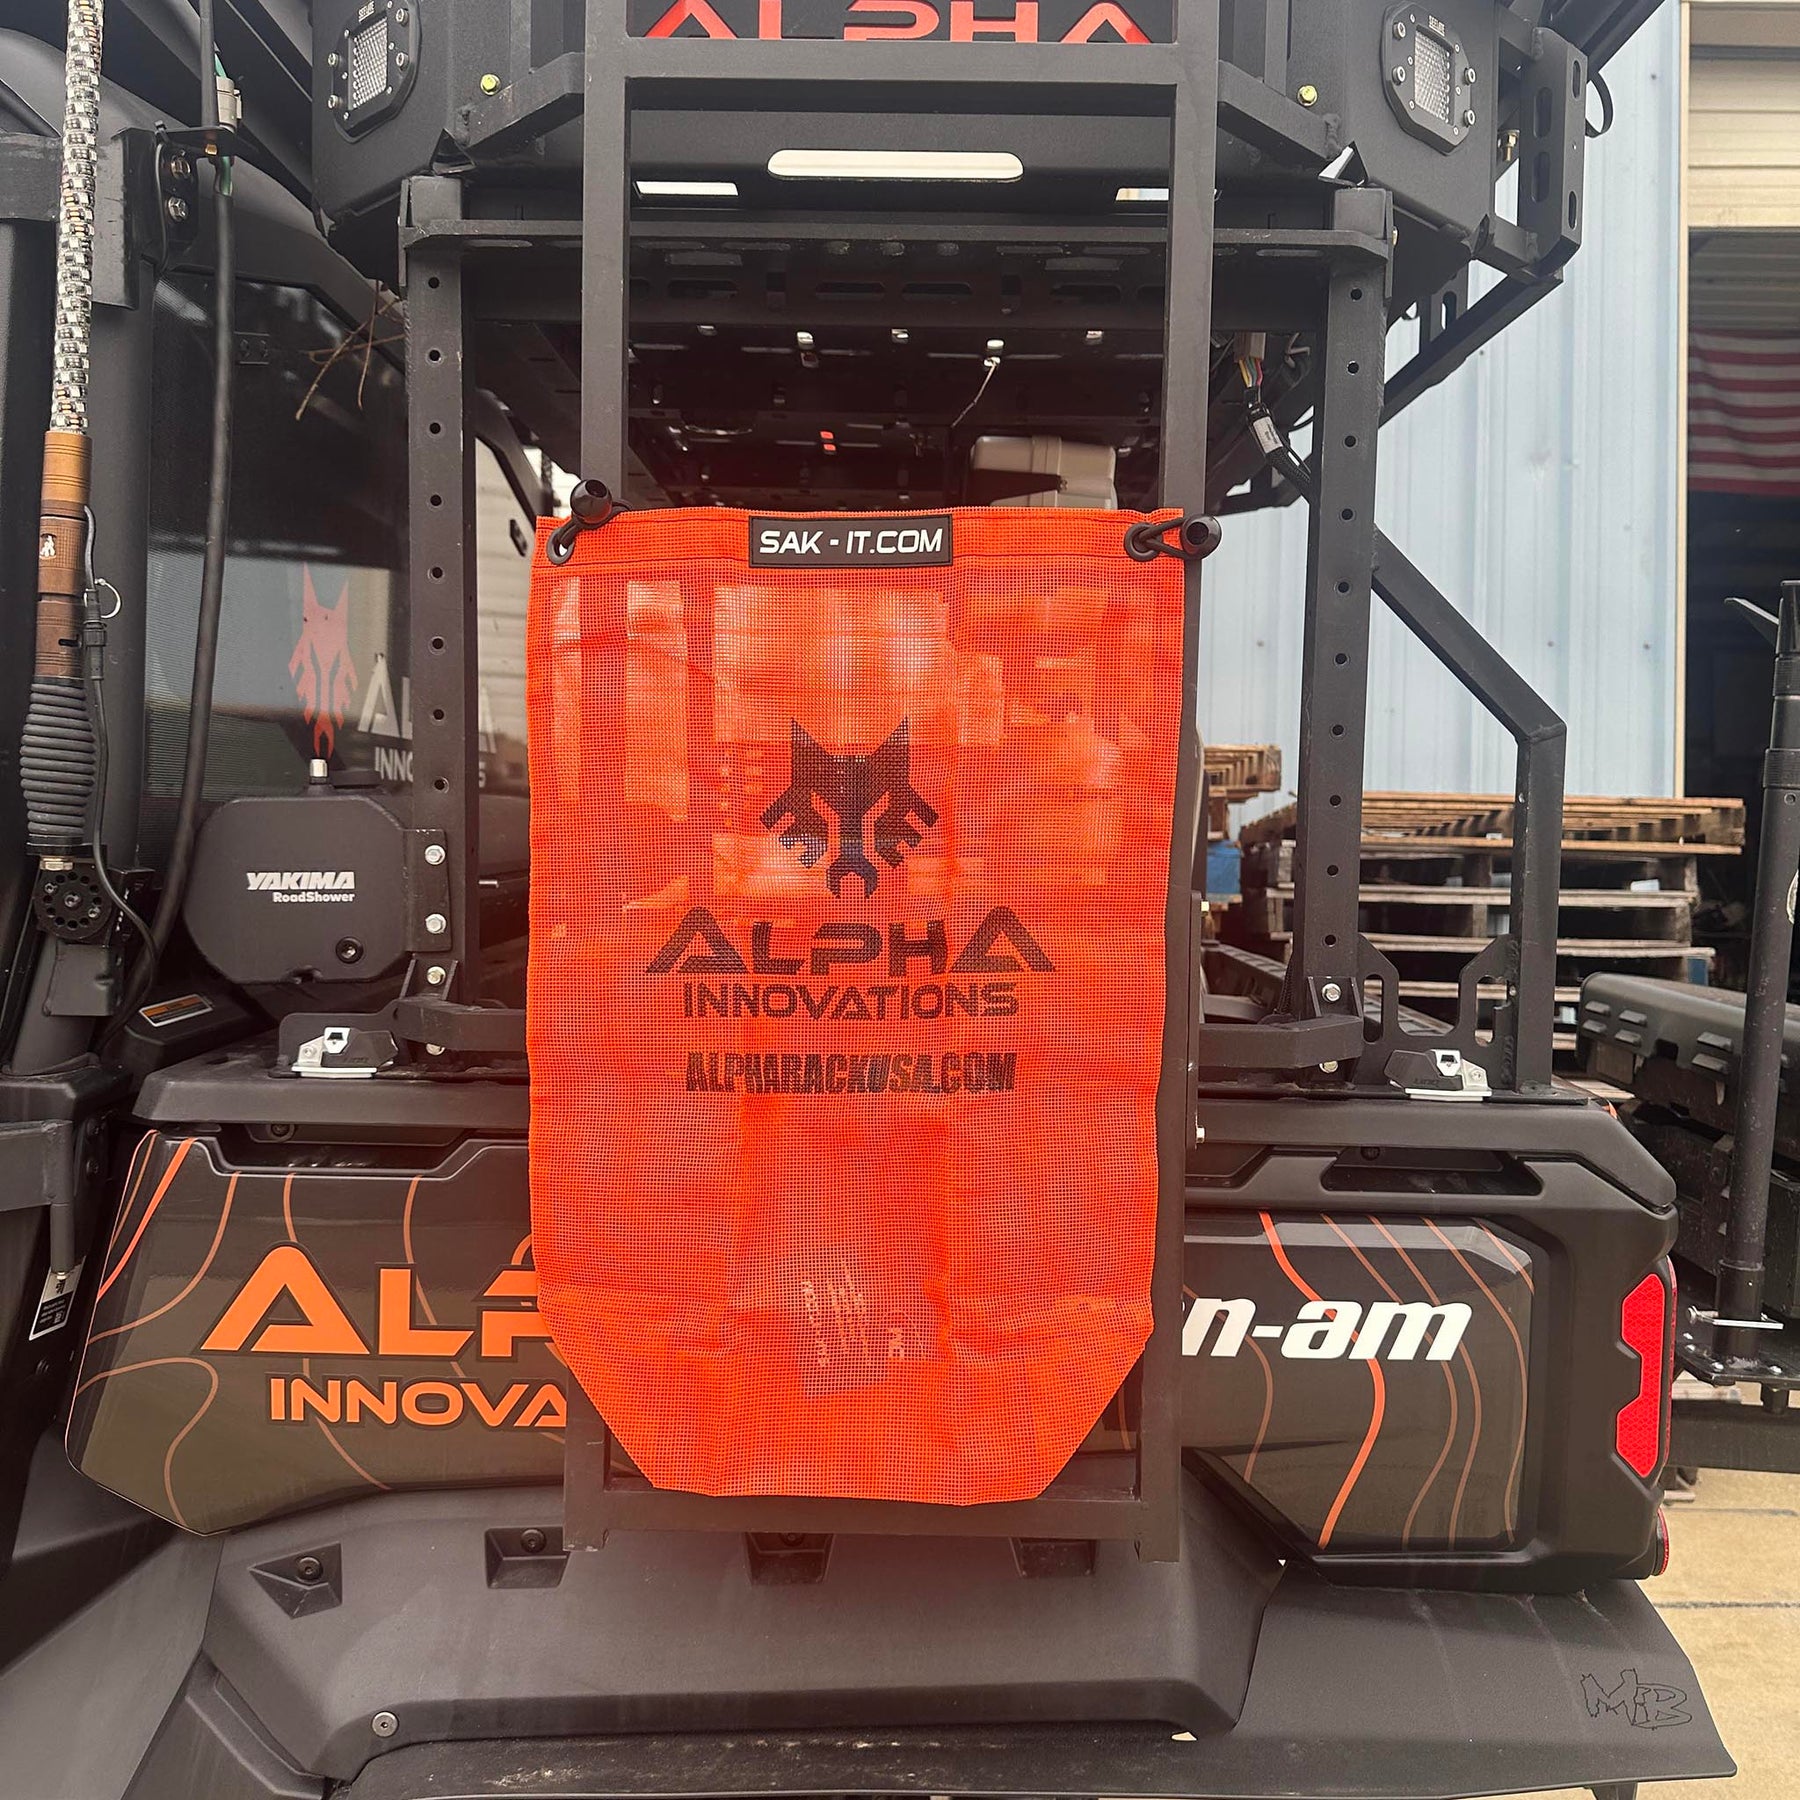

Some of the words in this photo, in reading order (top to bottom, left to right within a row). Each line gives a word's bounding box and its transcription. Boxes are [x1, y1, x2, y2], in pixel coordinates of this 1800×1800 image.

[759, 530, 824, 555] SAK
[846, 528, 943, 554] IT.COM
[246, 871, 355, 890] YAKIMA
[272, 891, 355, 902] RoadShower
[645, 906, 1057, 976] ALPHA
[684, 982, 1018, 1020] INNOVATIONS
[686, 1051, 1016, 1094] ALPHARACKUSA.COM
[269, 1378, 566, 1427] INNOVA
